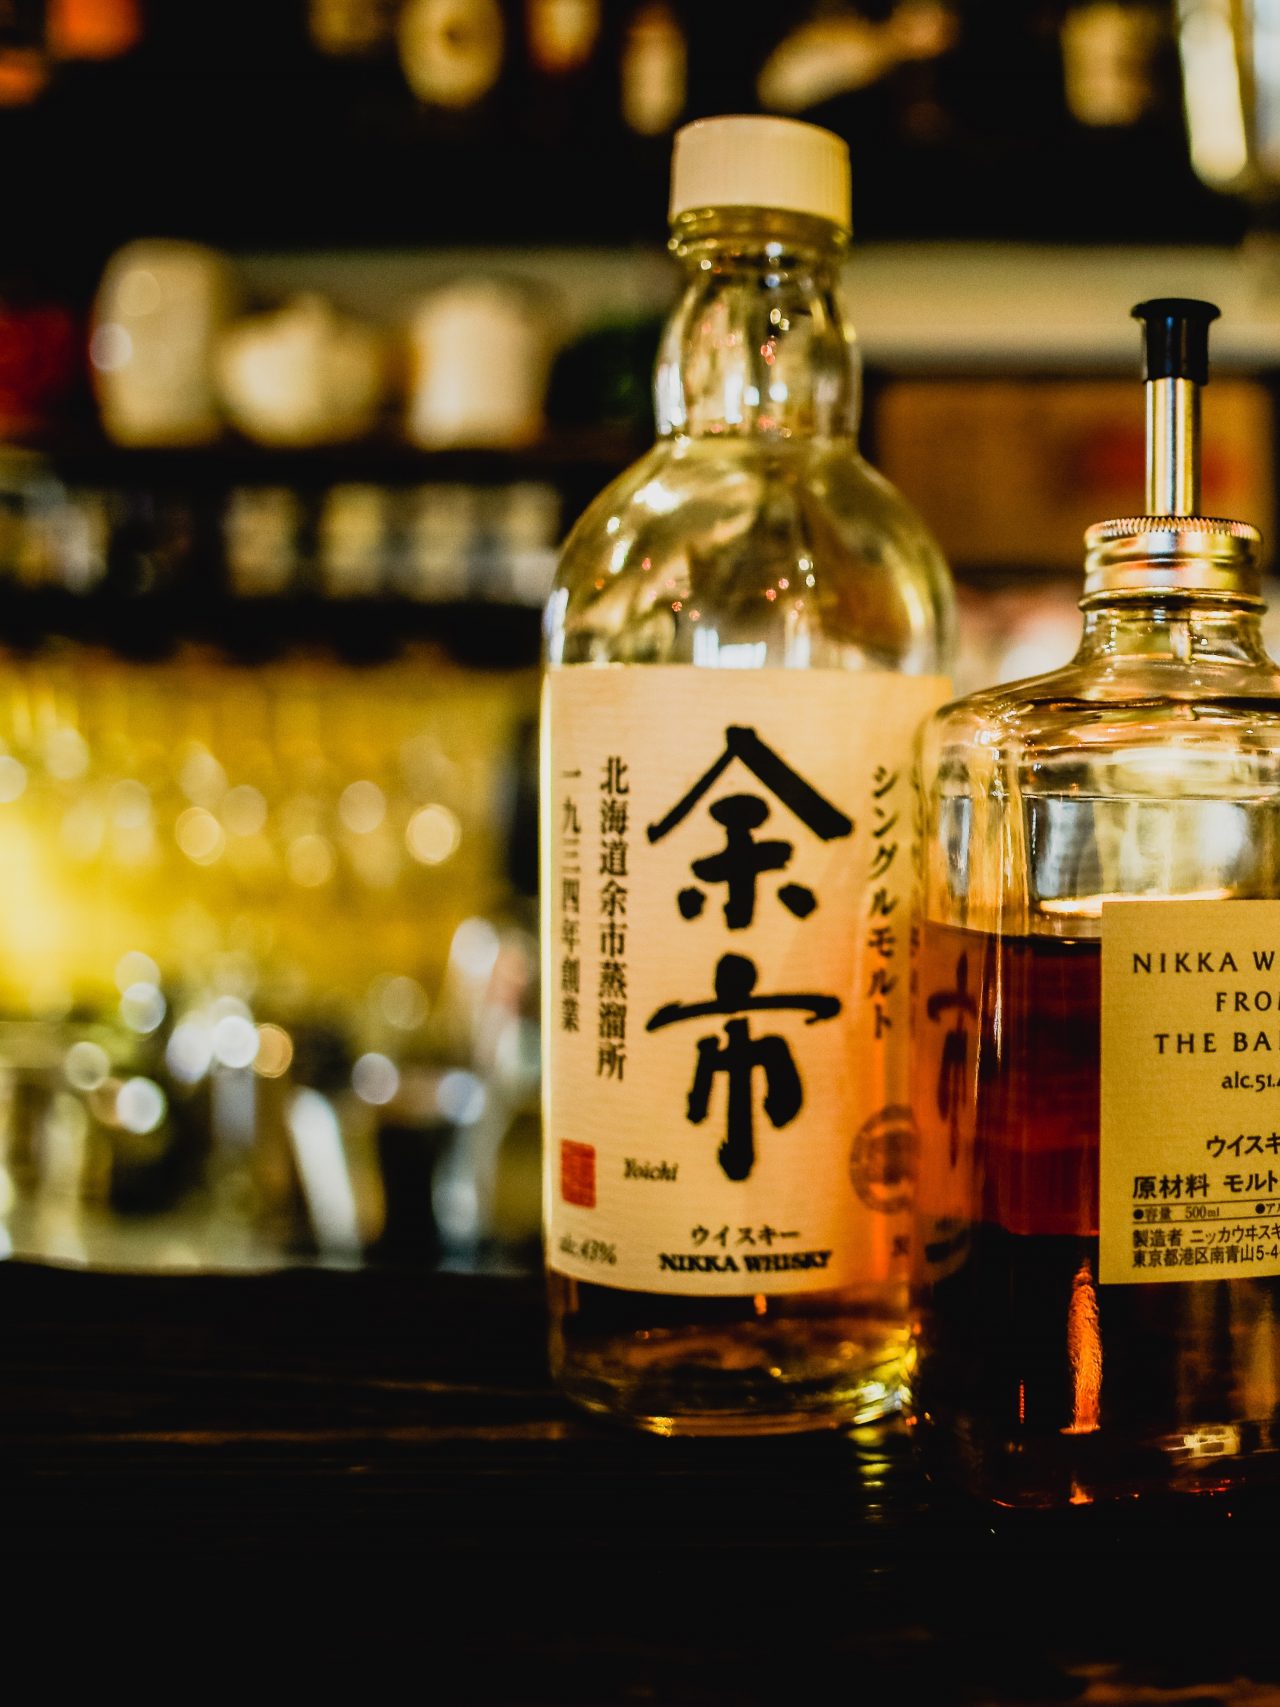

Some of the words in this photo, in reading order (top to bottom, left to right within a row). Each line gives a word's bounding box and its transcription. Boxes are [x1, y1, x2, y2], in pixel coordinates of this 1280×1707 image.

[868, 765, 899, 1039] シングルモルト
[597, 755, 630, 1082] 北海道余市蒸溜所
[646, 725, 854, 1182] 余市
[1133, 952, 1238, 974] NIKKA
[1154, 1032, 1217, 1055] THE
[623, 1157, 679, 1182] Yoichi
[1132, 1173, 1210, 1200] 原材料
[1184, 1206, 1220, 1219] 500ml
[690, 1224, 800, 1247] ウイスキー
[1132, 1228, 1183, 1248] 製造者
[658, 1252, 739, 1273] NIKKA
[743, 1250, 832, 1273] WHISKY
